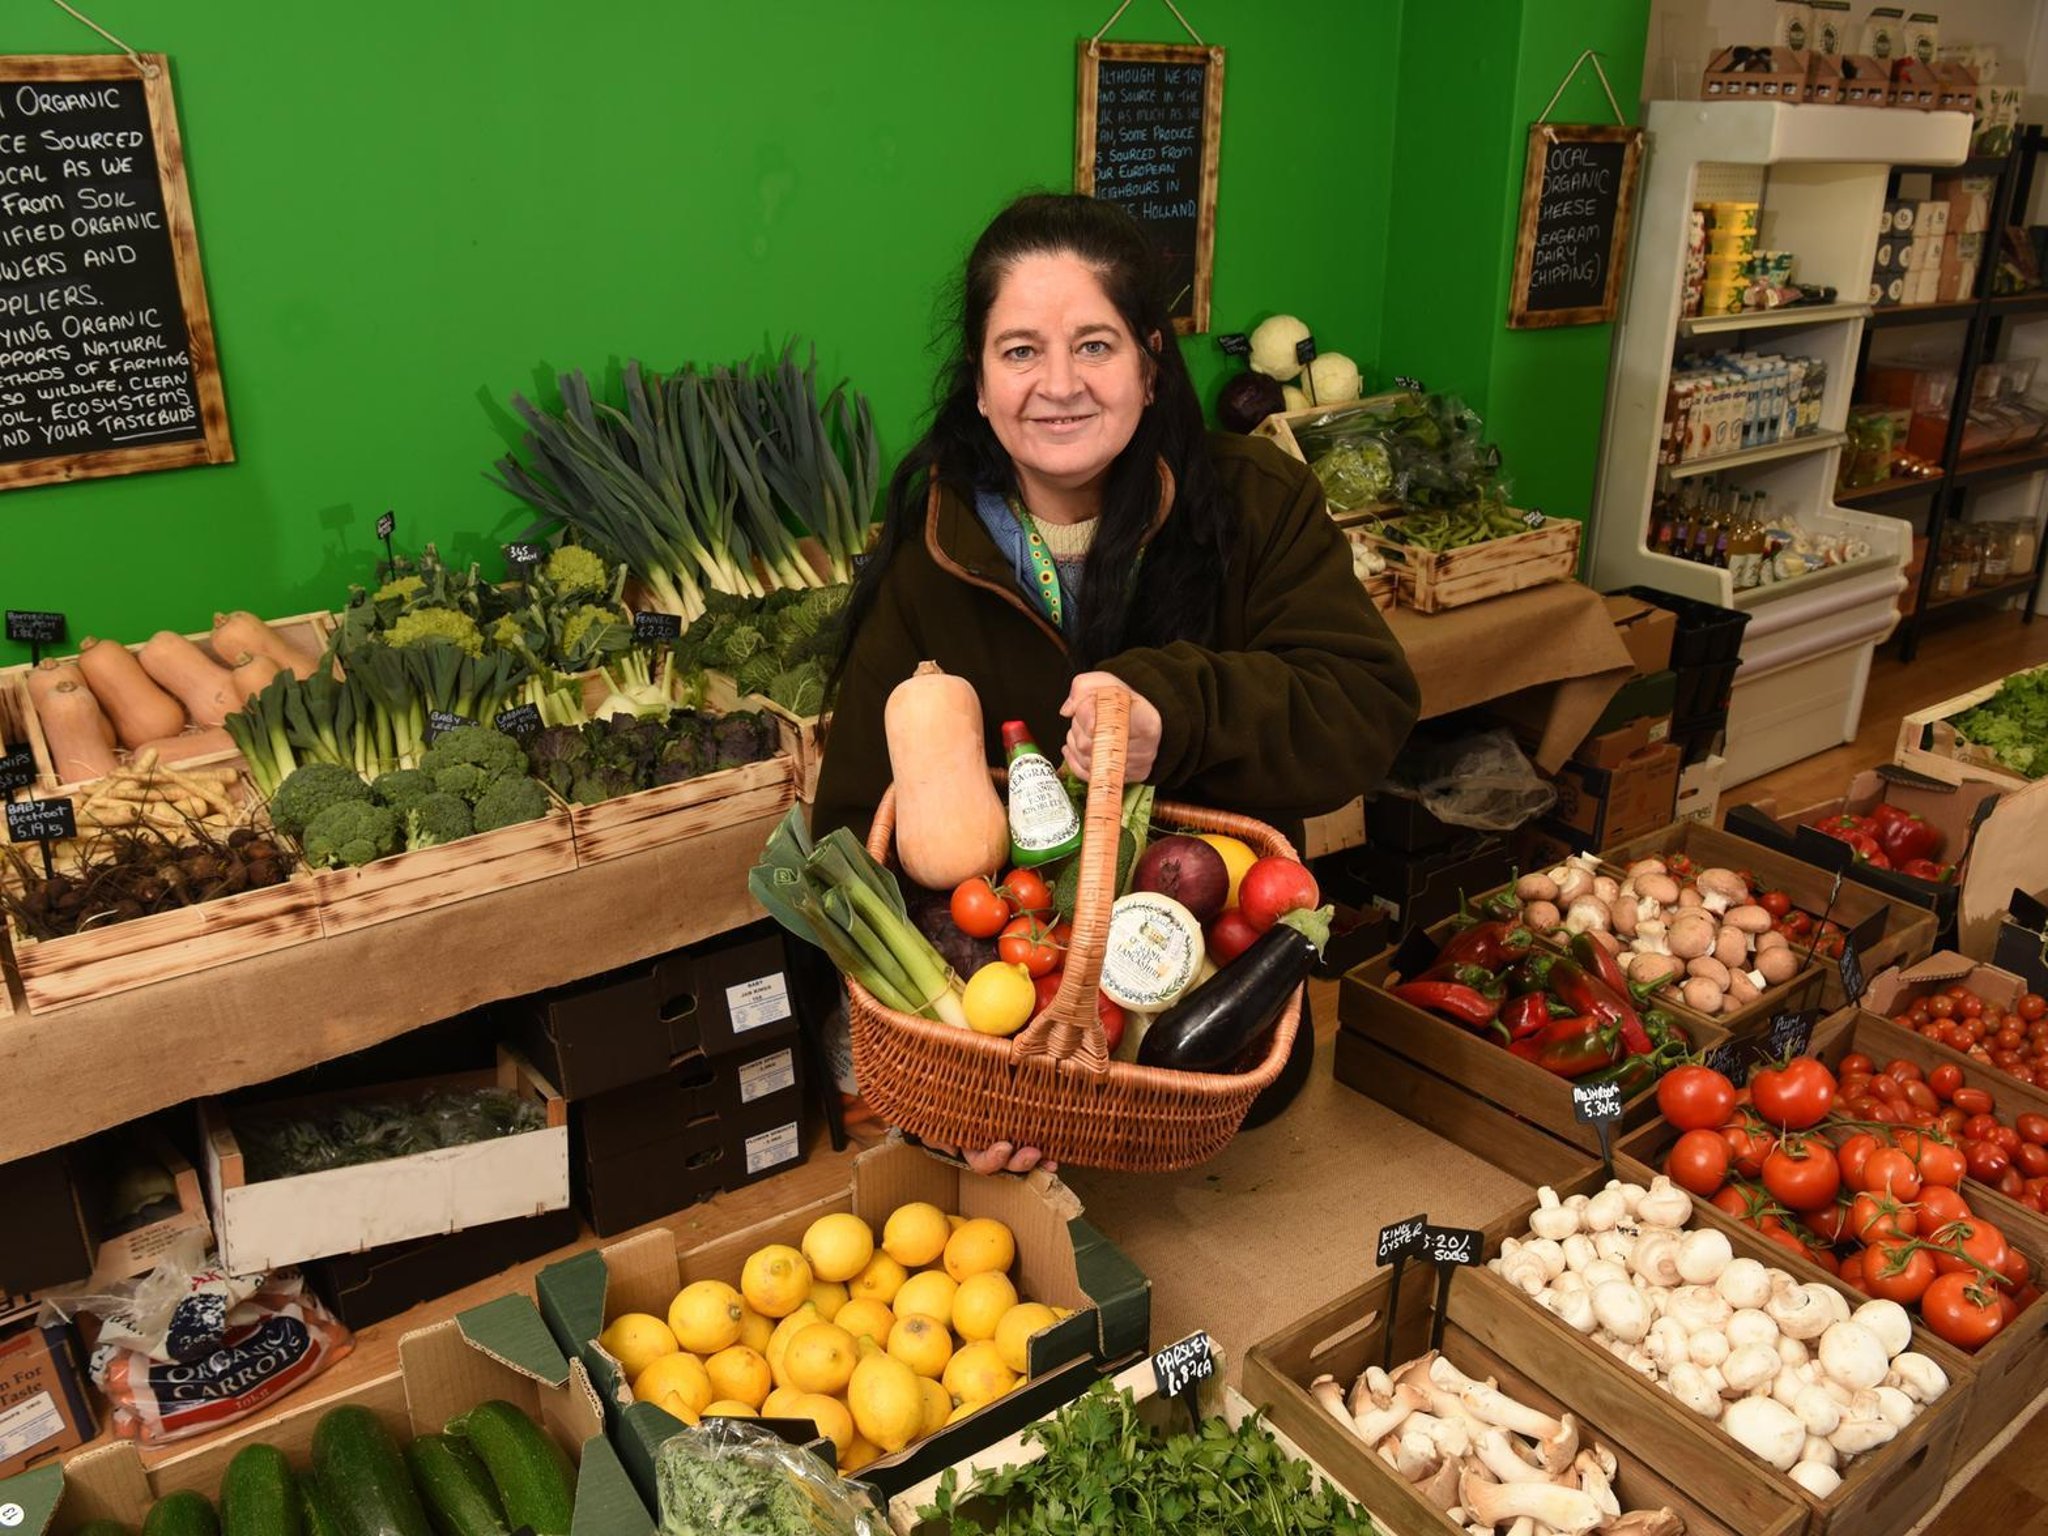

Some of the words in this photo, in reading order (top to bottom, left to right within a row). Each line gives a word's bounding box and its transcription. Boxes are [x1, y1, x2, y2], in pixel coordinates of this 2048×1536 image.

[16, 86, 120, 116] ORGANIC
[40, 129, 144, 151] SOURCED
[1119, 126, 1148, 142] SOME
[1153, 124, 1196, 141] PRODUCE
[1109, 148, 1157, 163] SOURCED
[1160, 144, 1193, 159] FROM
[63, 158, 91, 179] AS
[101, 157, 133, 176] WE
[1119, 162, 1177, 179] EUROPEAN
[1166, 180, 1180, 194] IN
[2, 192, 66, 217] FROM
[77, 188, 137, 209] SOIL
[71, 211, 161, 238] ORGANIC
[84, 245, 138, 268] AND
[1536, 245, 1578, 266] DAIRY
[62, 308, 163, 339] ORGANIC
[83, 335, 168, 357] NATURAL
[75, 361, 101, 377] OF
[109, 351, 190, 375] FARMING
[130, 371, 189, 391] CLEAN
[51, 388, 191, 421] ECOSYSTEMS
[40, 419, 93, 445] YOUR
[96, 405, 197, 435] TASTEBUDS
[8, 801, 45, 815] BABY
[1156, 1335, 1210, 1376] PARSLEY
[13, 1366, 42, 1382] For
[173, 1335, 300, 1400] CARROTS
